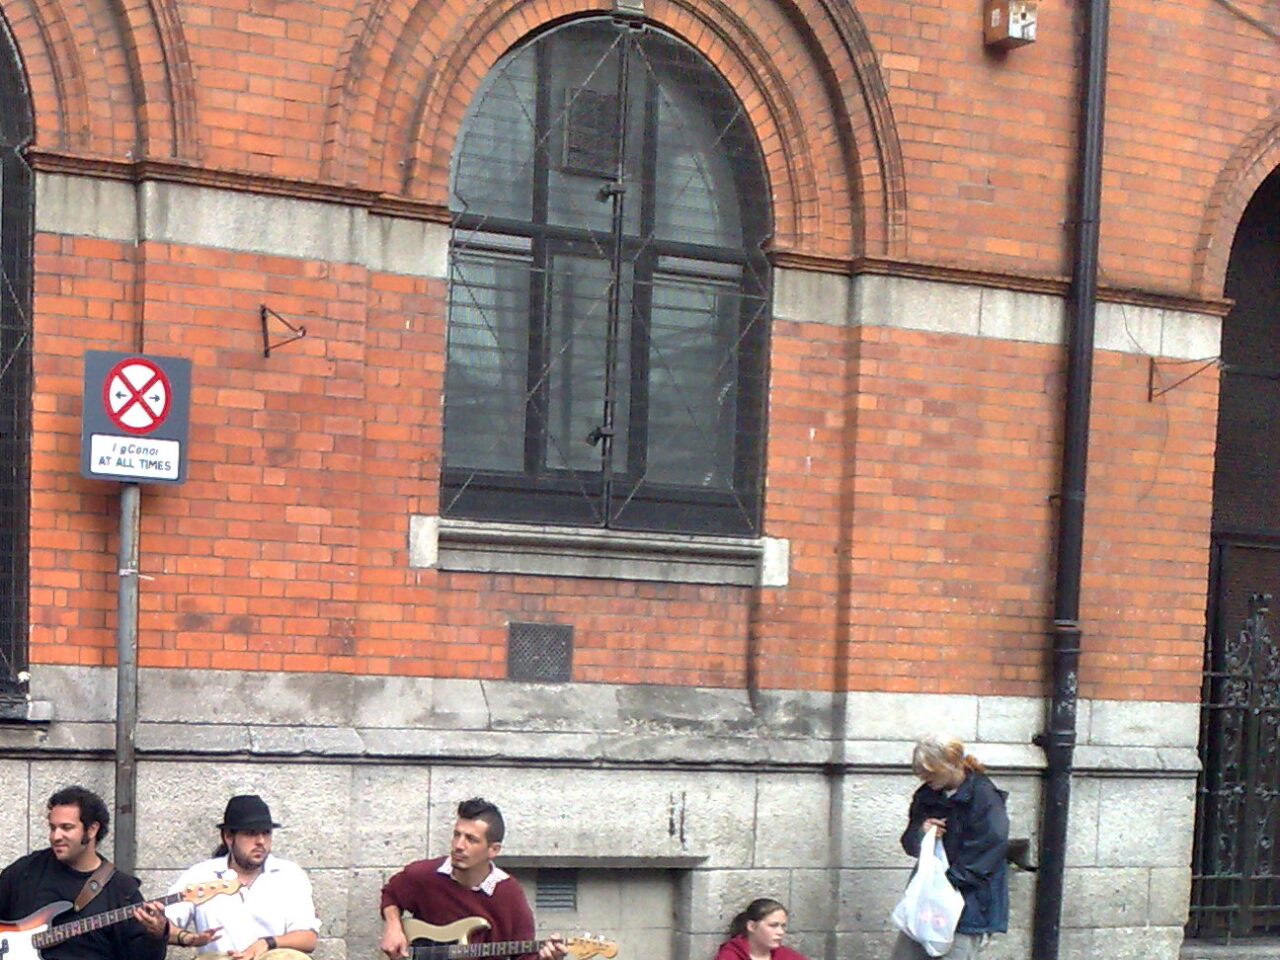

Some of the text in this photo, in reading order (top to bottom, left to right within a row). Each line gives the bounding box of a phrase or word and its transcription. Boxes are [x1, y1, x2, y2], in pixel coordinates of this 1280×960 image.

[98, 455, 171, 470] AT ALL TIMES
